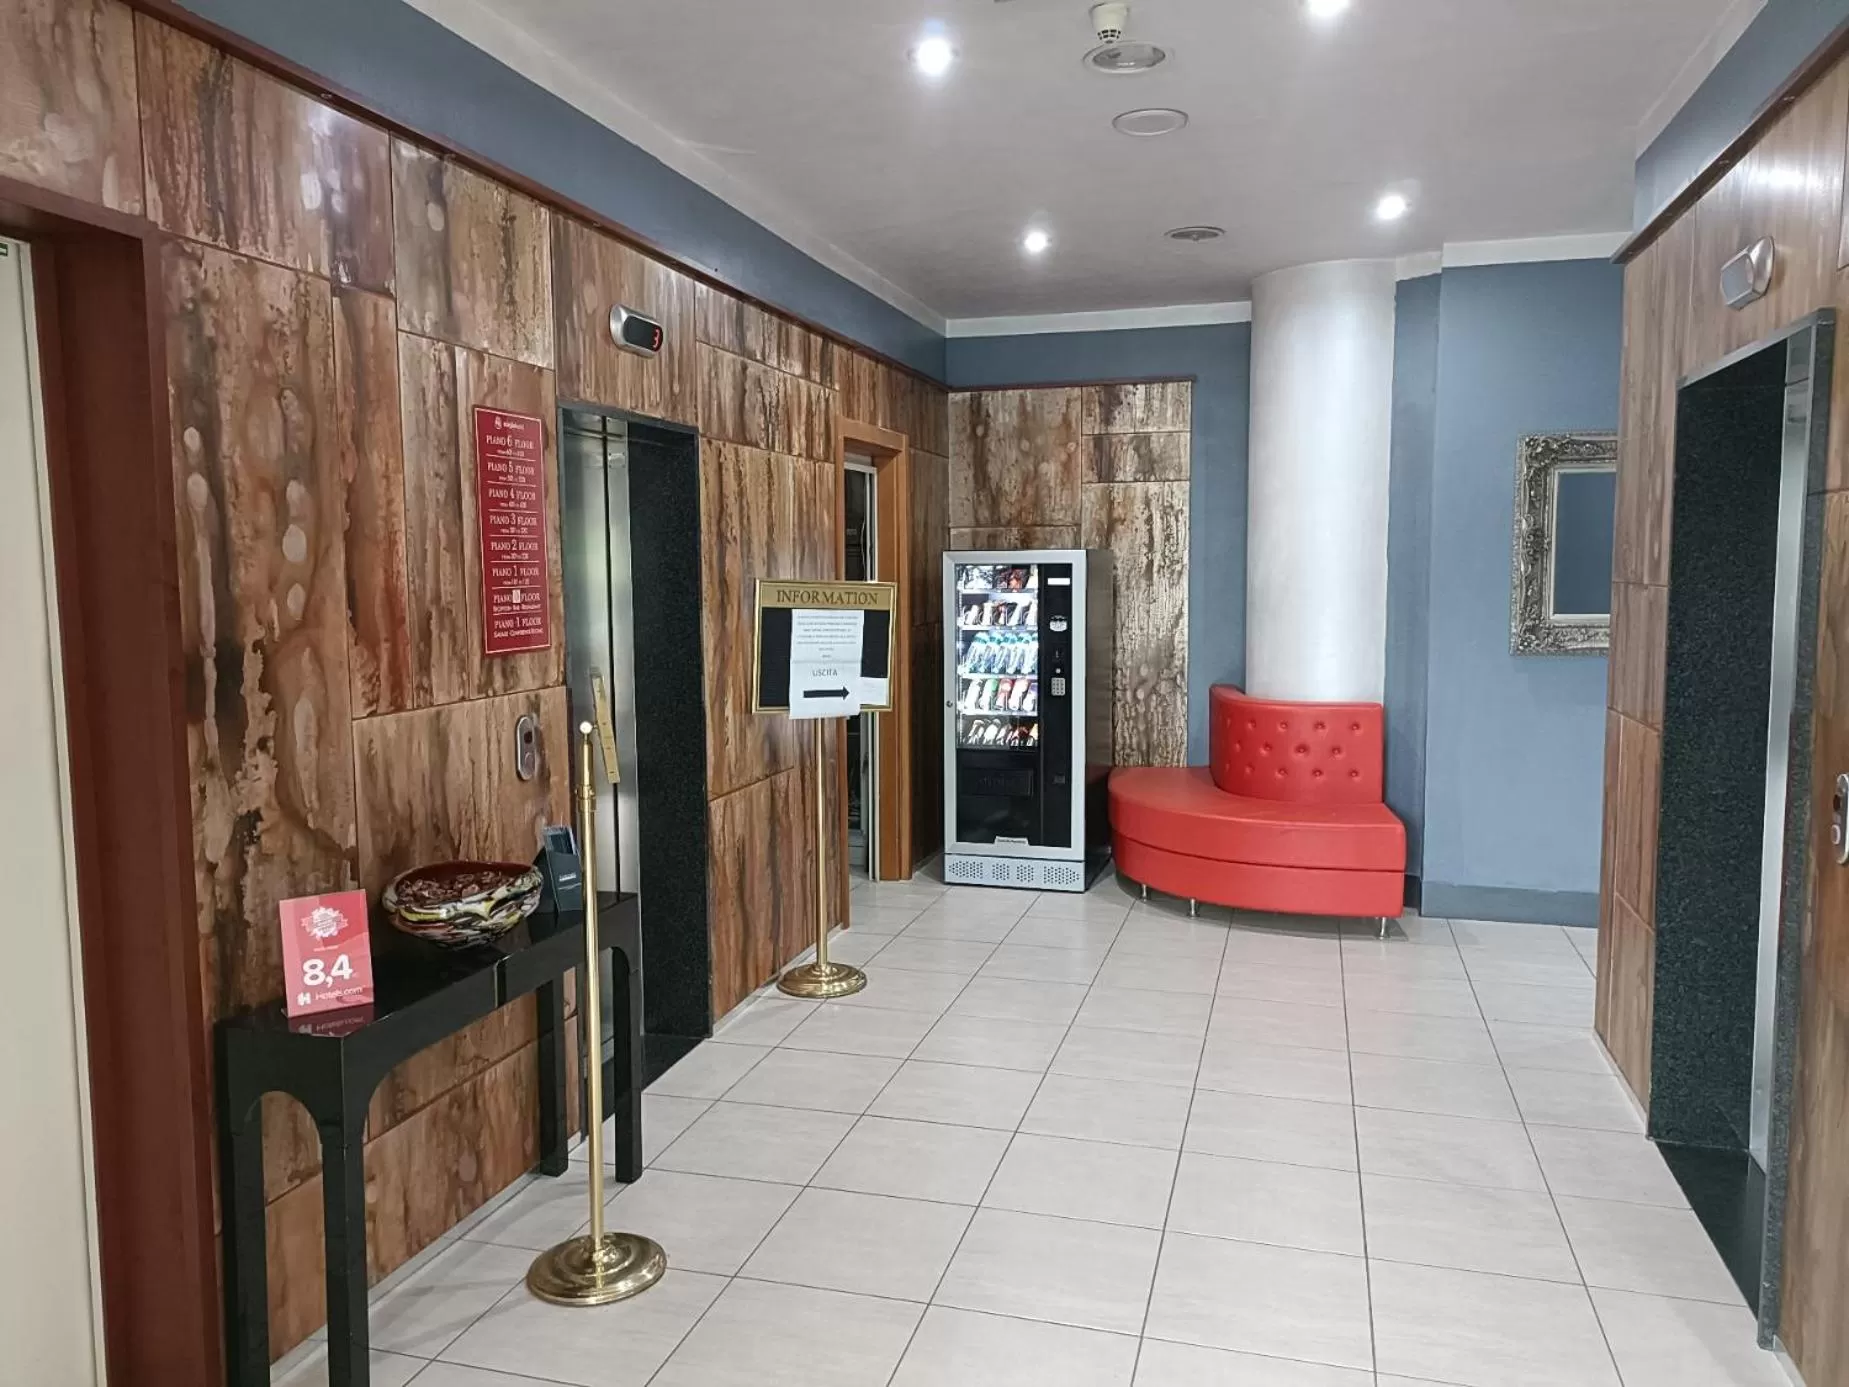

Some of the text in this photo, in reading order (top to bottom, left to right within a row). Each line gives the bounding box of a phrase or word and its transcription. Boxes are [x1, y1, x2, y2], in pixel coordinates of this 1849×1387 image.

[653, 328, 661, 349] 3
[486, 434, 535, 450] PIANO 6 FLOOR
[487, 460, 535, 476] PIANO 5 FLOOR
[488, 487, 536, 501] PIANO 4 FLOOR
[489, 512, 538, 526] PIANO 3 FLOOR
[490, 538, 539, 551] PIANO 2 FLOOR
[492, 565, 540, 577] PIANO 1 FLOOR
[493, 589, 541, 604] PIANO 0 FLOOR
[776, 589, 879, 606] INFORMATION
[494, 619, 514, 629] PIANO
[521, 616, 542, 627] FLOOR
[812, 669, 838, 678] USCITA
[302, 953, 354, 988] 8,4
[315, 985, 364, 1001] Hotels.com
